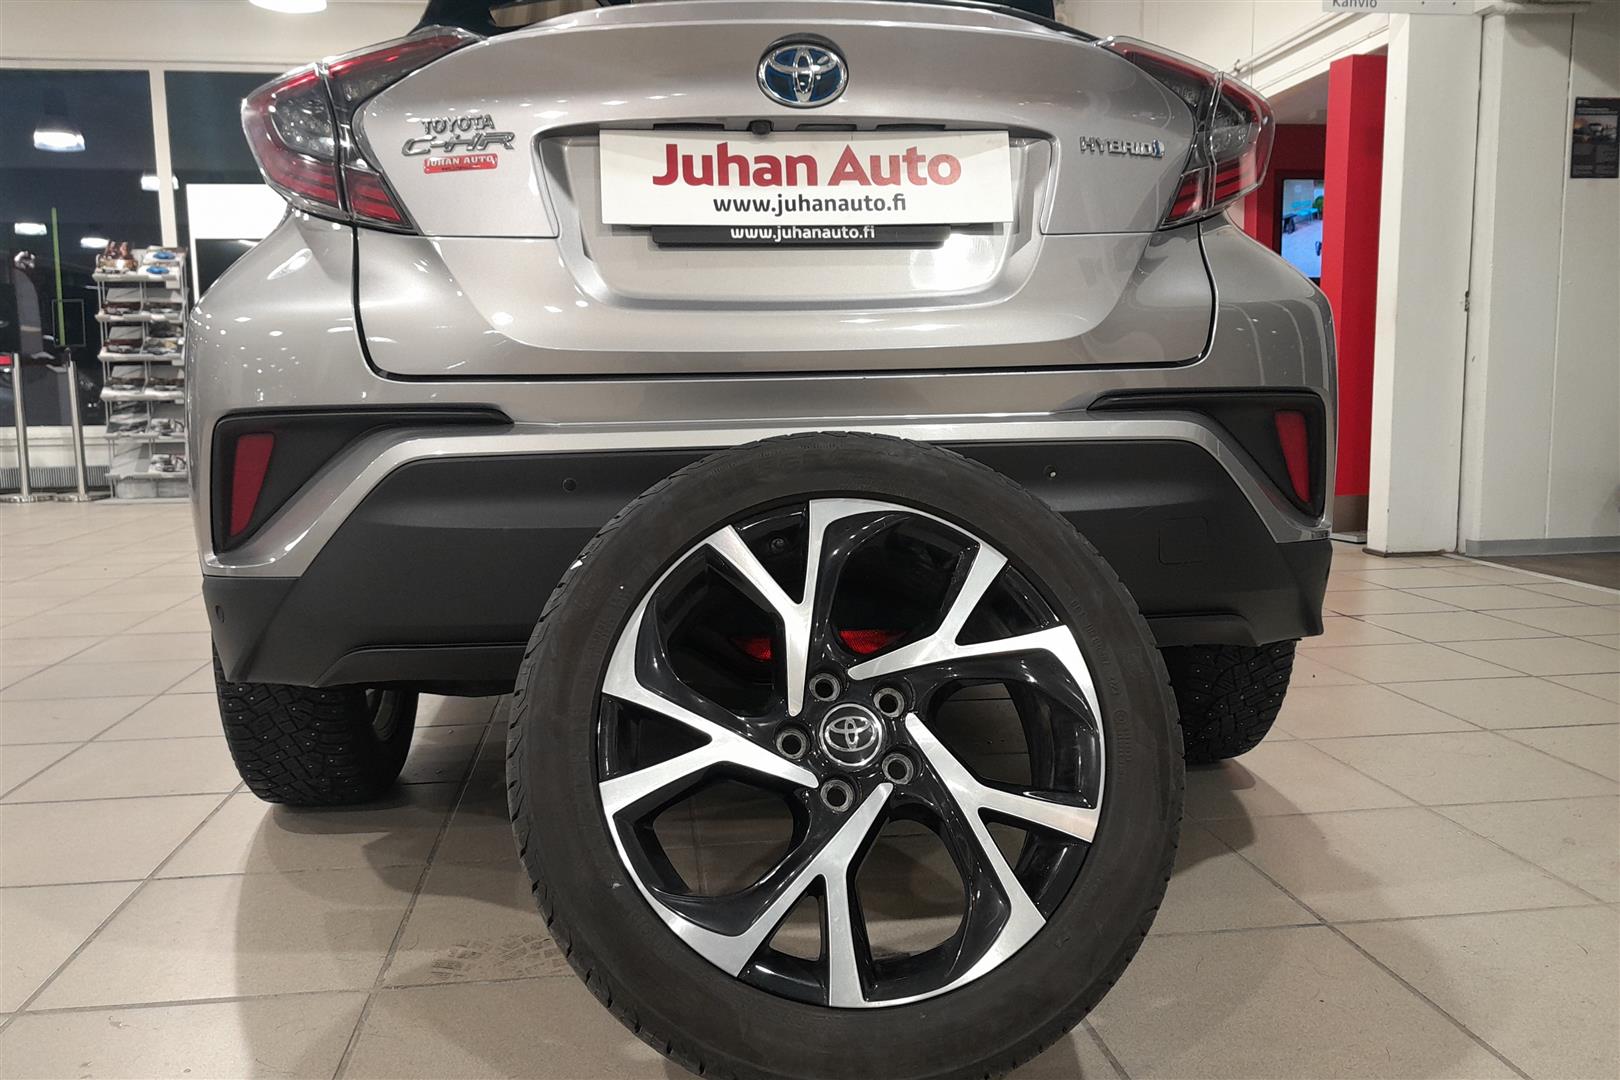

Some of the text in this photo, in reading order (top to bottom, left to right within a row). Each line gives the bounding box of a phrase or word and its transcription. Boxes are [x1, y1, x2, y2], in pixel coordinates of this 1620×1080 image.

[422, 114, 495, 134] TOYOTA
[463, 155, 495, 164] AUTO
[652, 142, 962, 187] Juhan Auto
[713, 193, 906, 216] www.juhanauto.fi
[730, 225, 876, 241] www.juhanauto.fi
